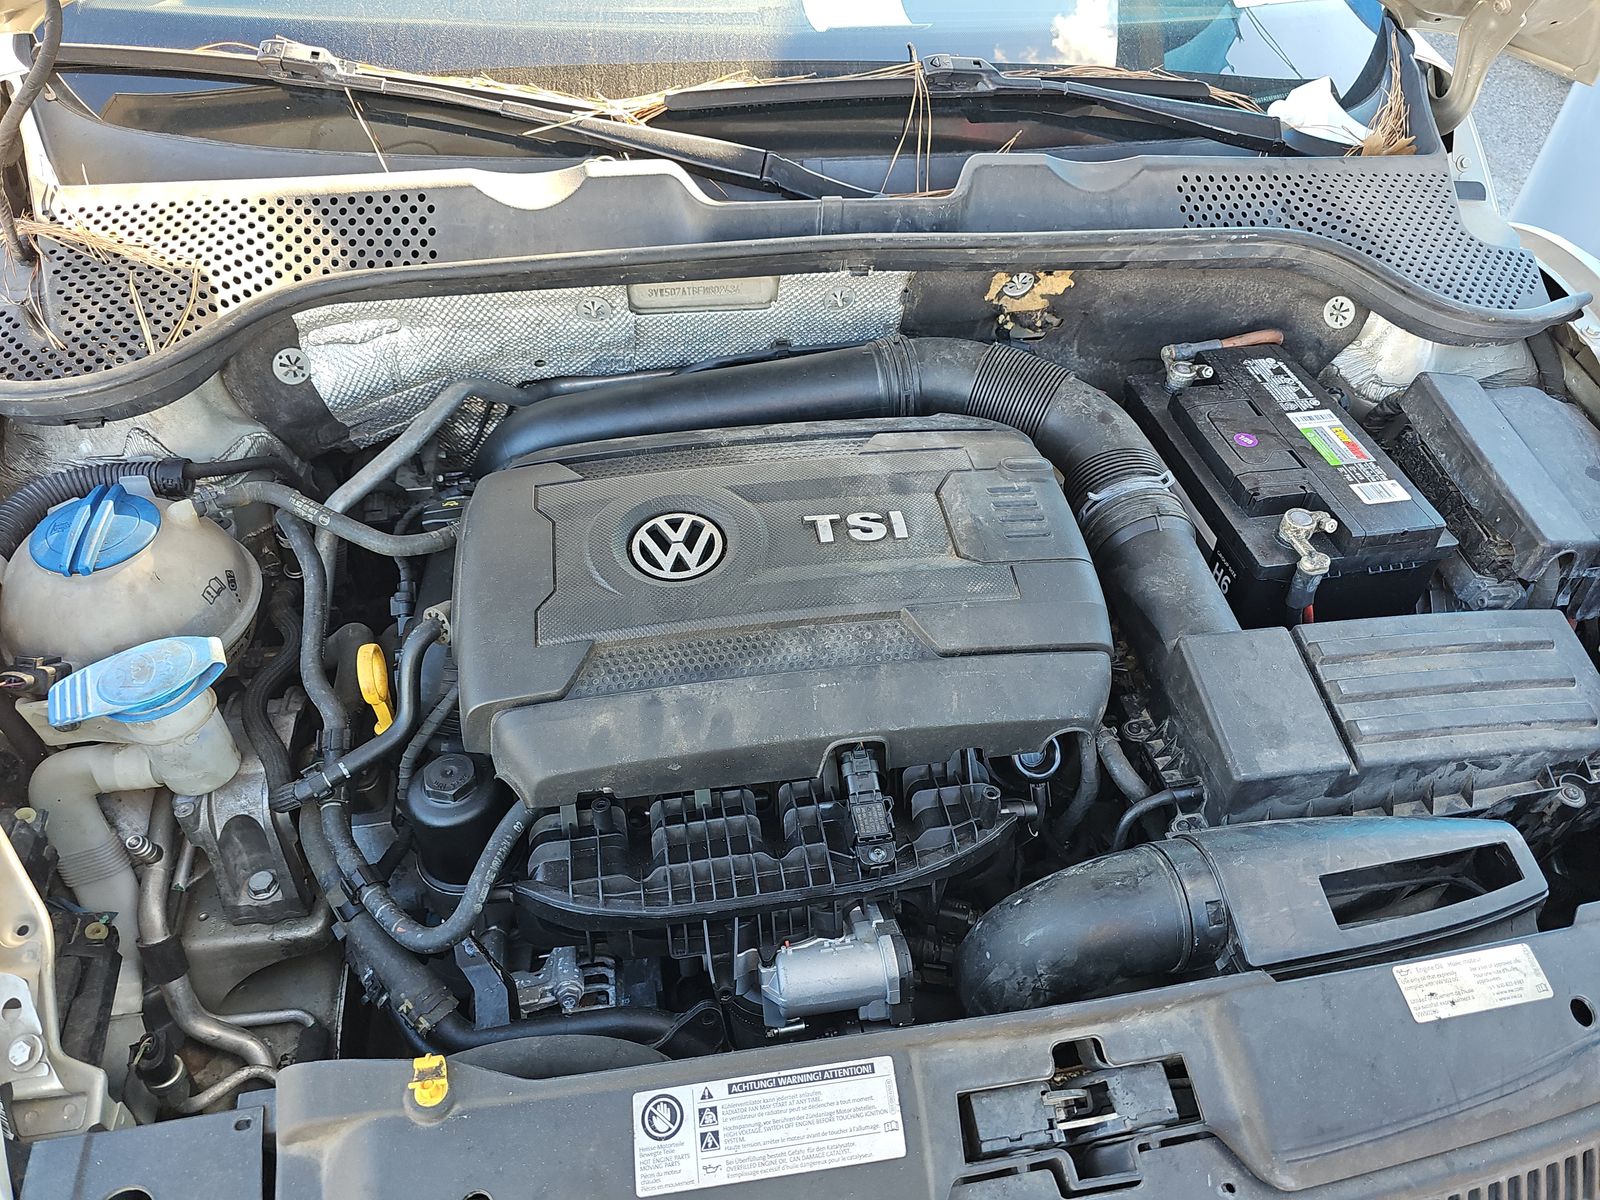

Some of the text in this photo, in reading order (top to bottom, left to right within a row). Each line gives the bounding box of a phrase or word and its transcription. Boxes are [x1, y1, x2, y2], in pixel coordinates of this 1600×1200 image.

[630, 511, 909, 581] VW TSI
[1213, 562, 1231, 594] H6
[731, 1063, 872, 1093] ACHTUNG! WARNING! ATTENTION!
[721, 1107, 746, 1115] RADIATOR
[772, 1100, 787, 1108] START
[728, 1112, 756, 1121] ventilateur
[764, 1107, 787, 1116] radiateur
[788, 1105, 800, 1113] peut
[763, 1124, 783, 1132] SWITCH
[795, 1119, 814, 1127] ENGINE
[815, 1116, 834, 1124] BEFORE
[836, 1111, 863, 1121] TOUCHING
[864, 1108, 888, 1116] IGNITION
[786, 1134, 804, 1142] moteur
[805, 1131, 820, 1139] avant
[828, 1127, 847, 1135] toucher
[652, 1156, 672, 1164] ENGINE
[726, 1162, 756, 1172] OVERFILLED
[757, 1159, 777, 1167] ENGINE
[801, 1151, 824, 1160] DAMAGE
[766, 1151, 786, 1159] besteht
[828, 1156, 841, 1164] pour
